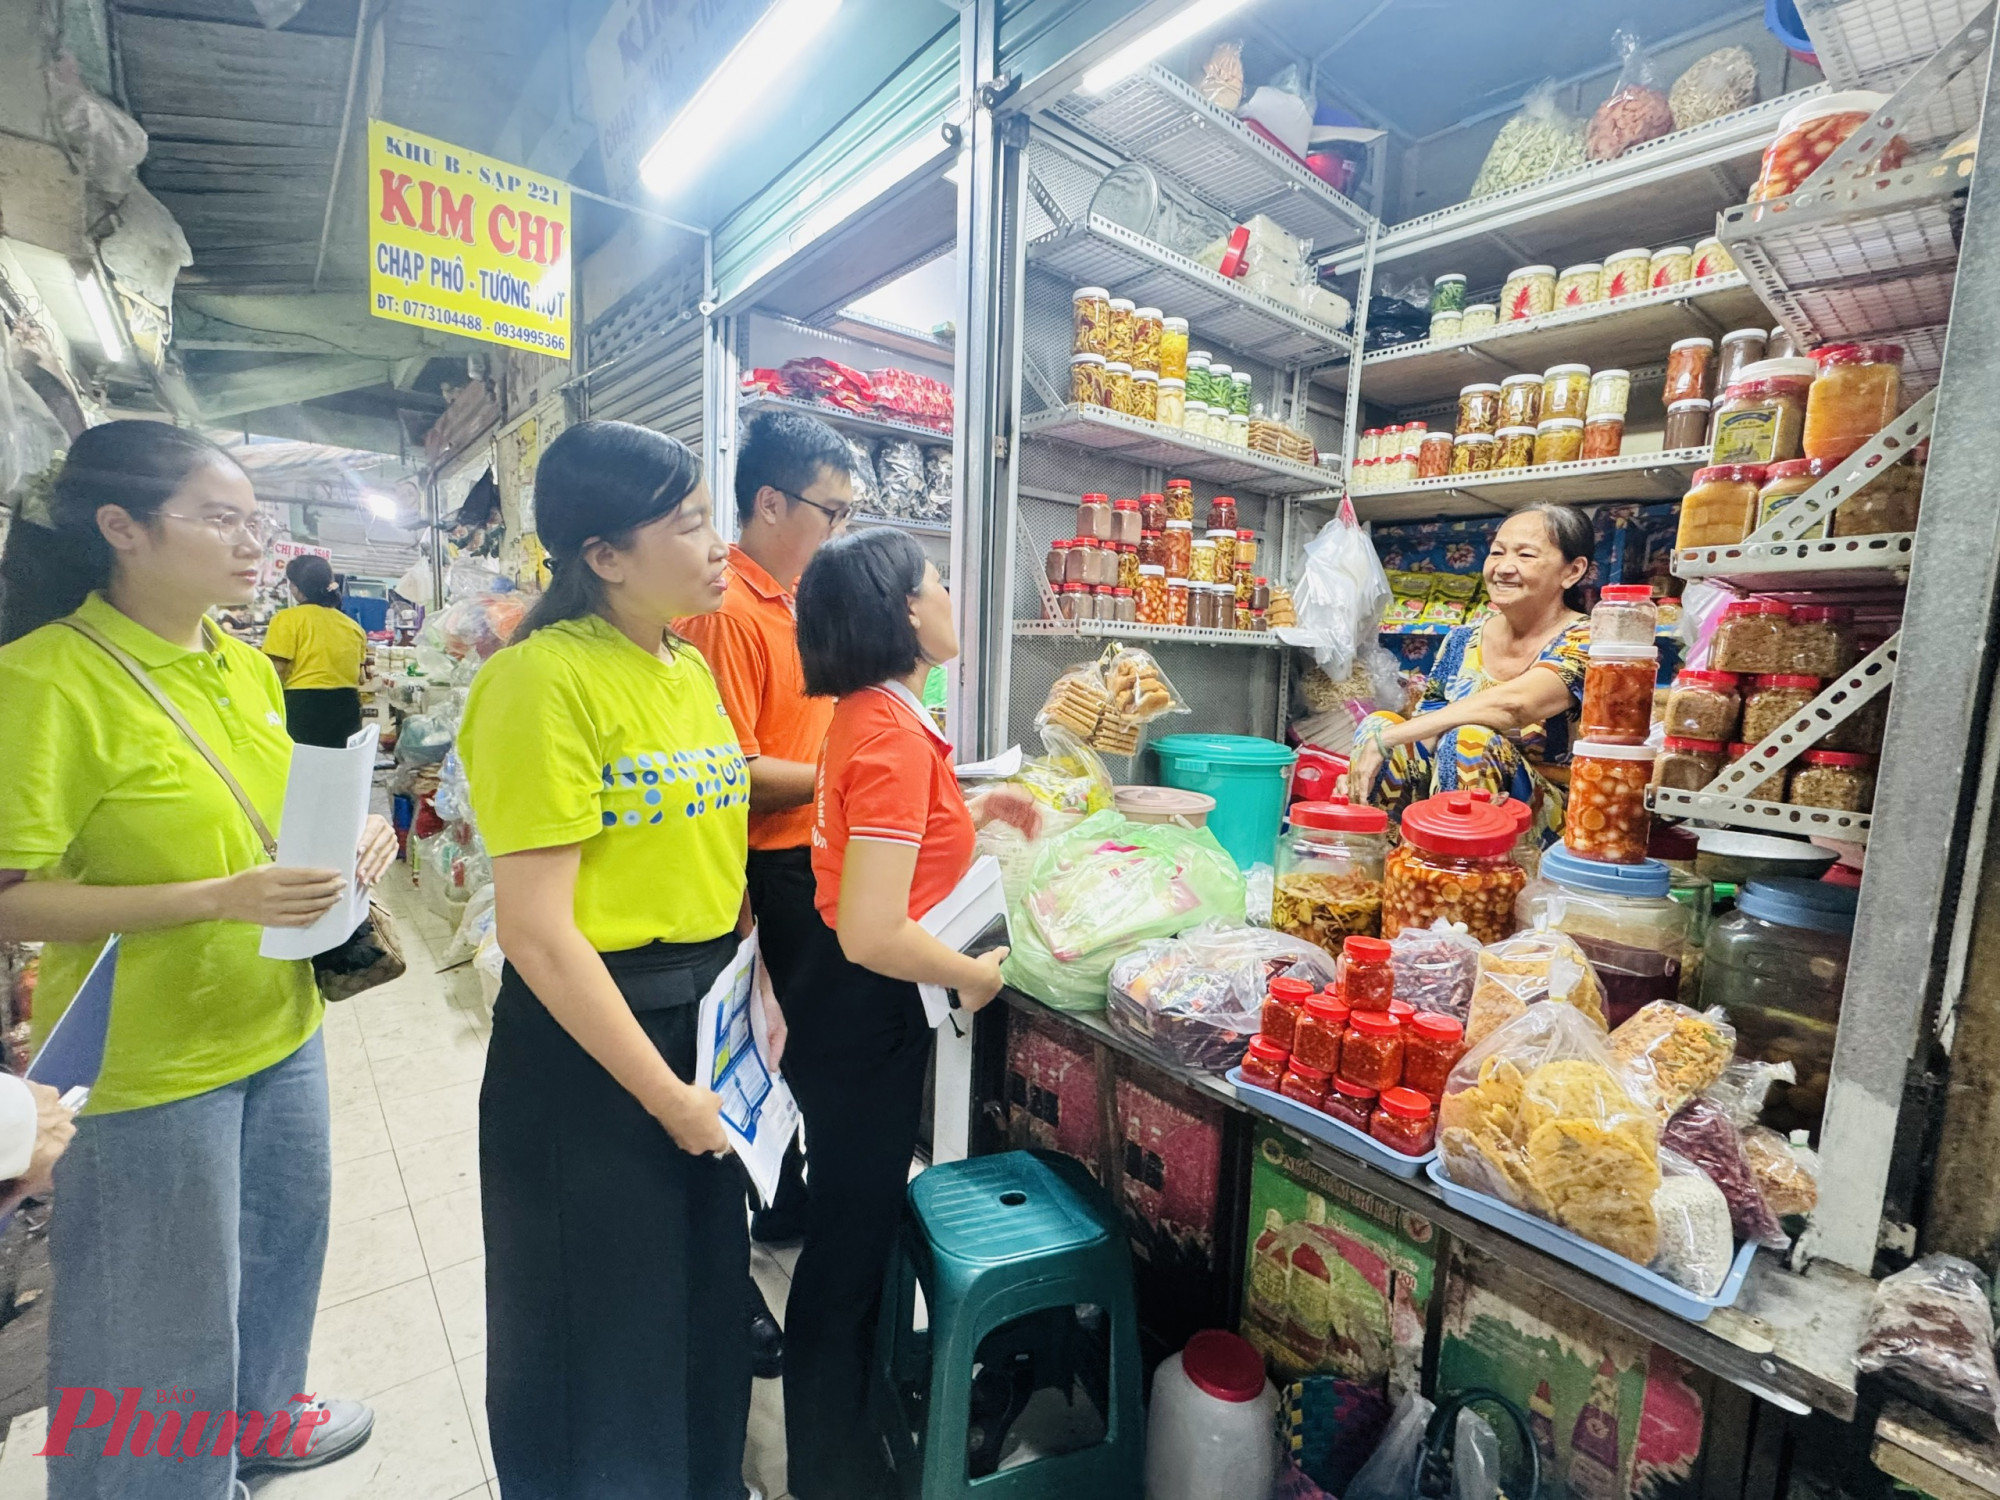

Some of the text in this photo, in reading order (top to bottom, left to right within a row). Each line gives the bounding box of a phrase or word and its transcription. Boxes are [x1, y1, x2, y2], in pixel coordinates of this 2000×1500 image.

[386, 135, 436, 167] KHU
[445, 154, 460, 174] B
[479, 166, 521, 193] SẠP
[527, 181, 559, 206] 221
[379, 168, 565, 266] KIM CHI
[377, 242, 425, 287] CHẠP
[430, 255, 464, 293] PHÔ
[479, 268, 531, 310] TƯƠNG
[377, 293, 399, 314] ĐT:
[403, 299, 482, 332] 0773104488
[494, 321, 565, 351] 0934995366
